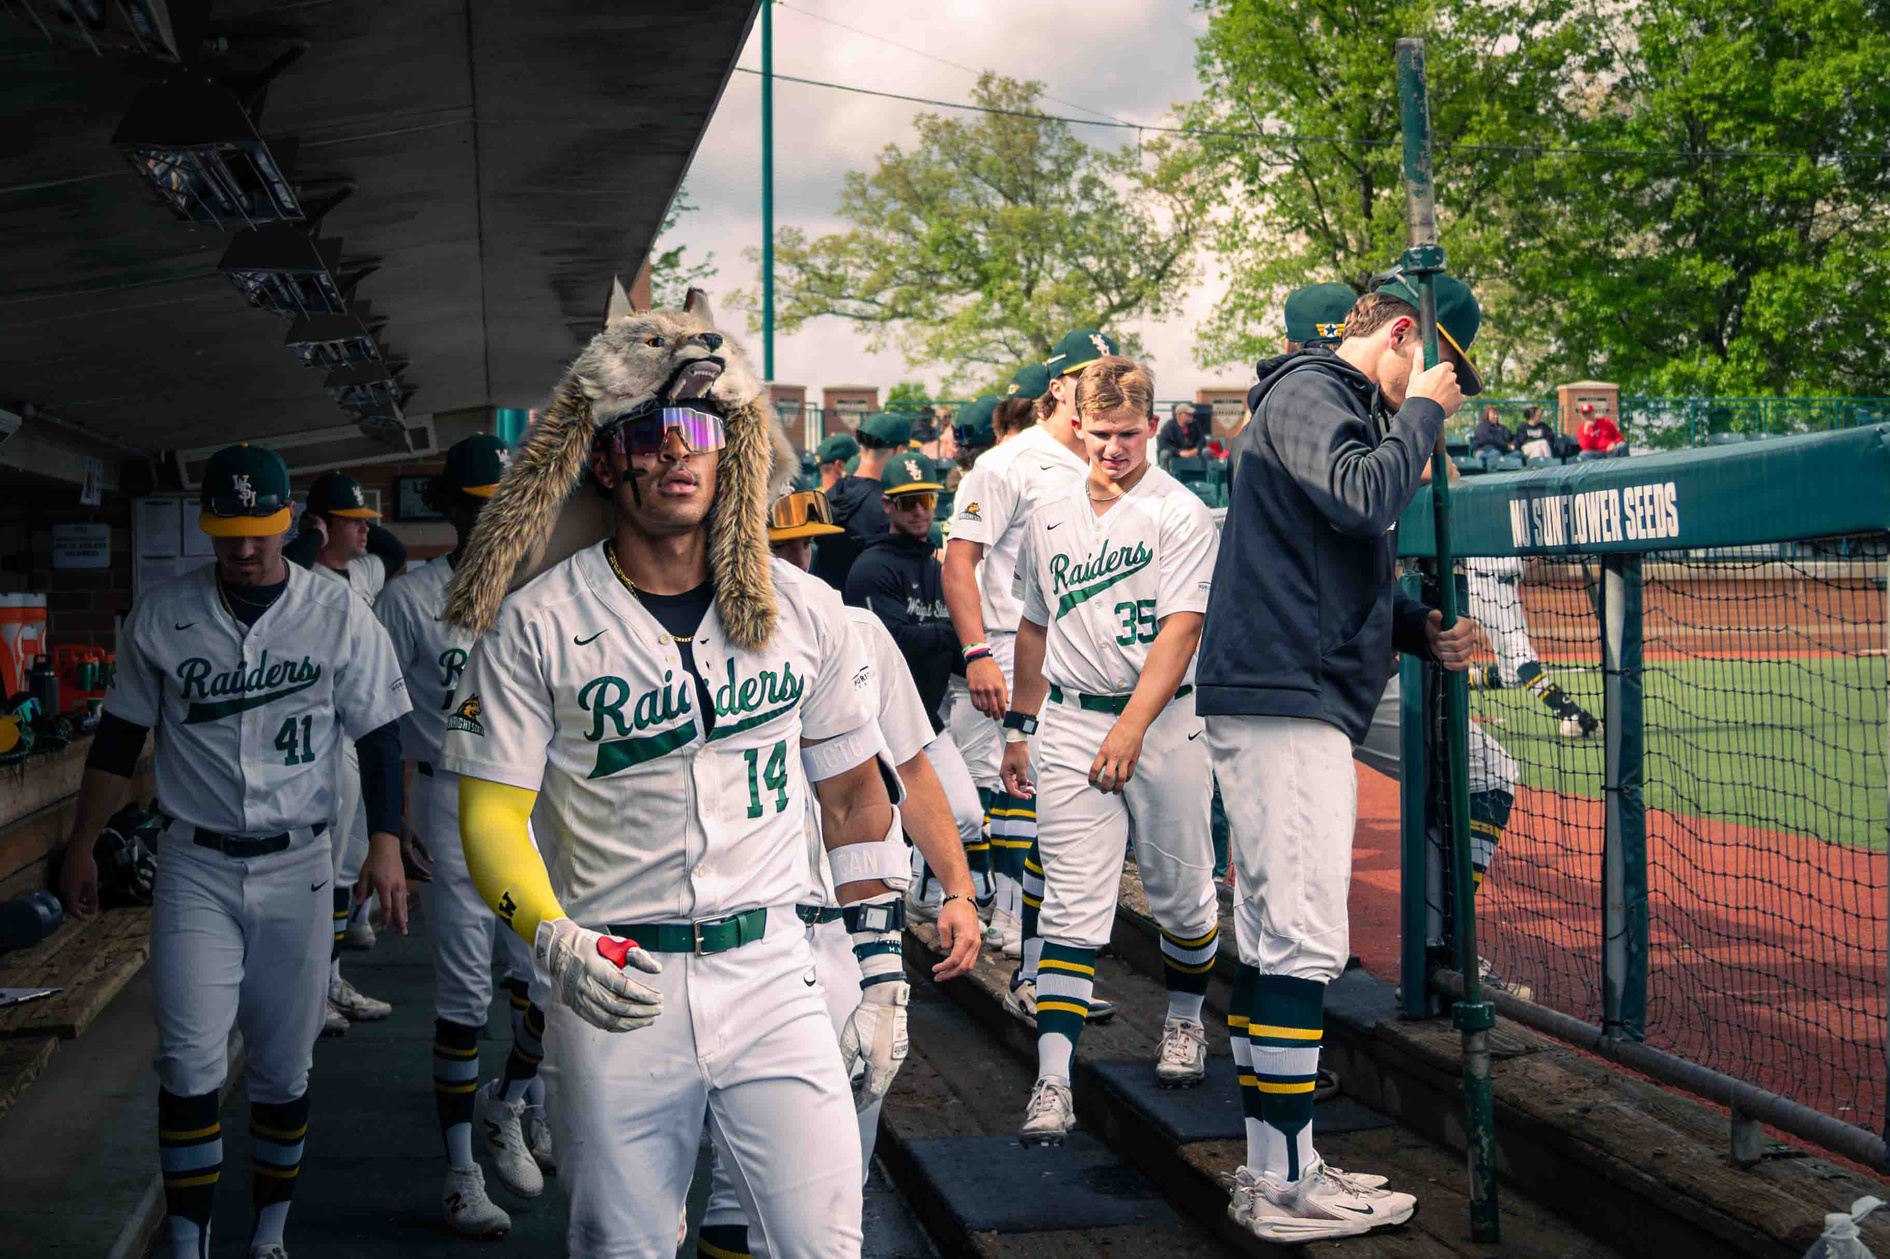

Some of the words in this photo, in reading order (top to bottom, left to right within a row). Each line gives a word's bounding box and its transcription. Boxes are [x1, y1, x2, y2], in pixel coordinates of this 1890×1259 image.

[1509, 499, 1531, 548] NO
[1532, 488, 1624, 547] SUNFLOWER
[1623, 481, 1680, 541] SEEDS
[1050, 538, 1153, 595] Raiders
[1114, 599, 1159, 647] 35
[176, 649, 321, 699] Raiders
[577, 656, 804, 742] Raiders
[274, 714, 316, 767] 41
[744, 739, 789, 819] 14
